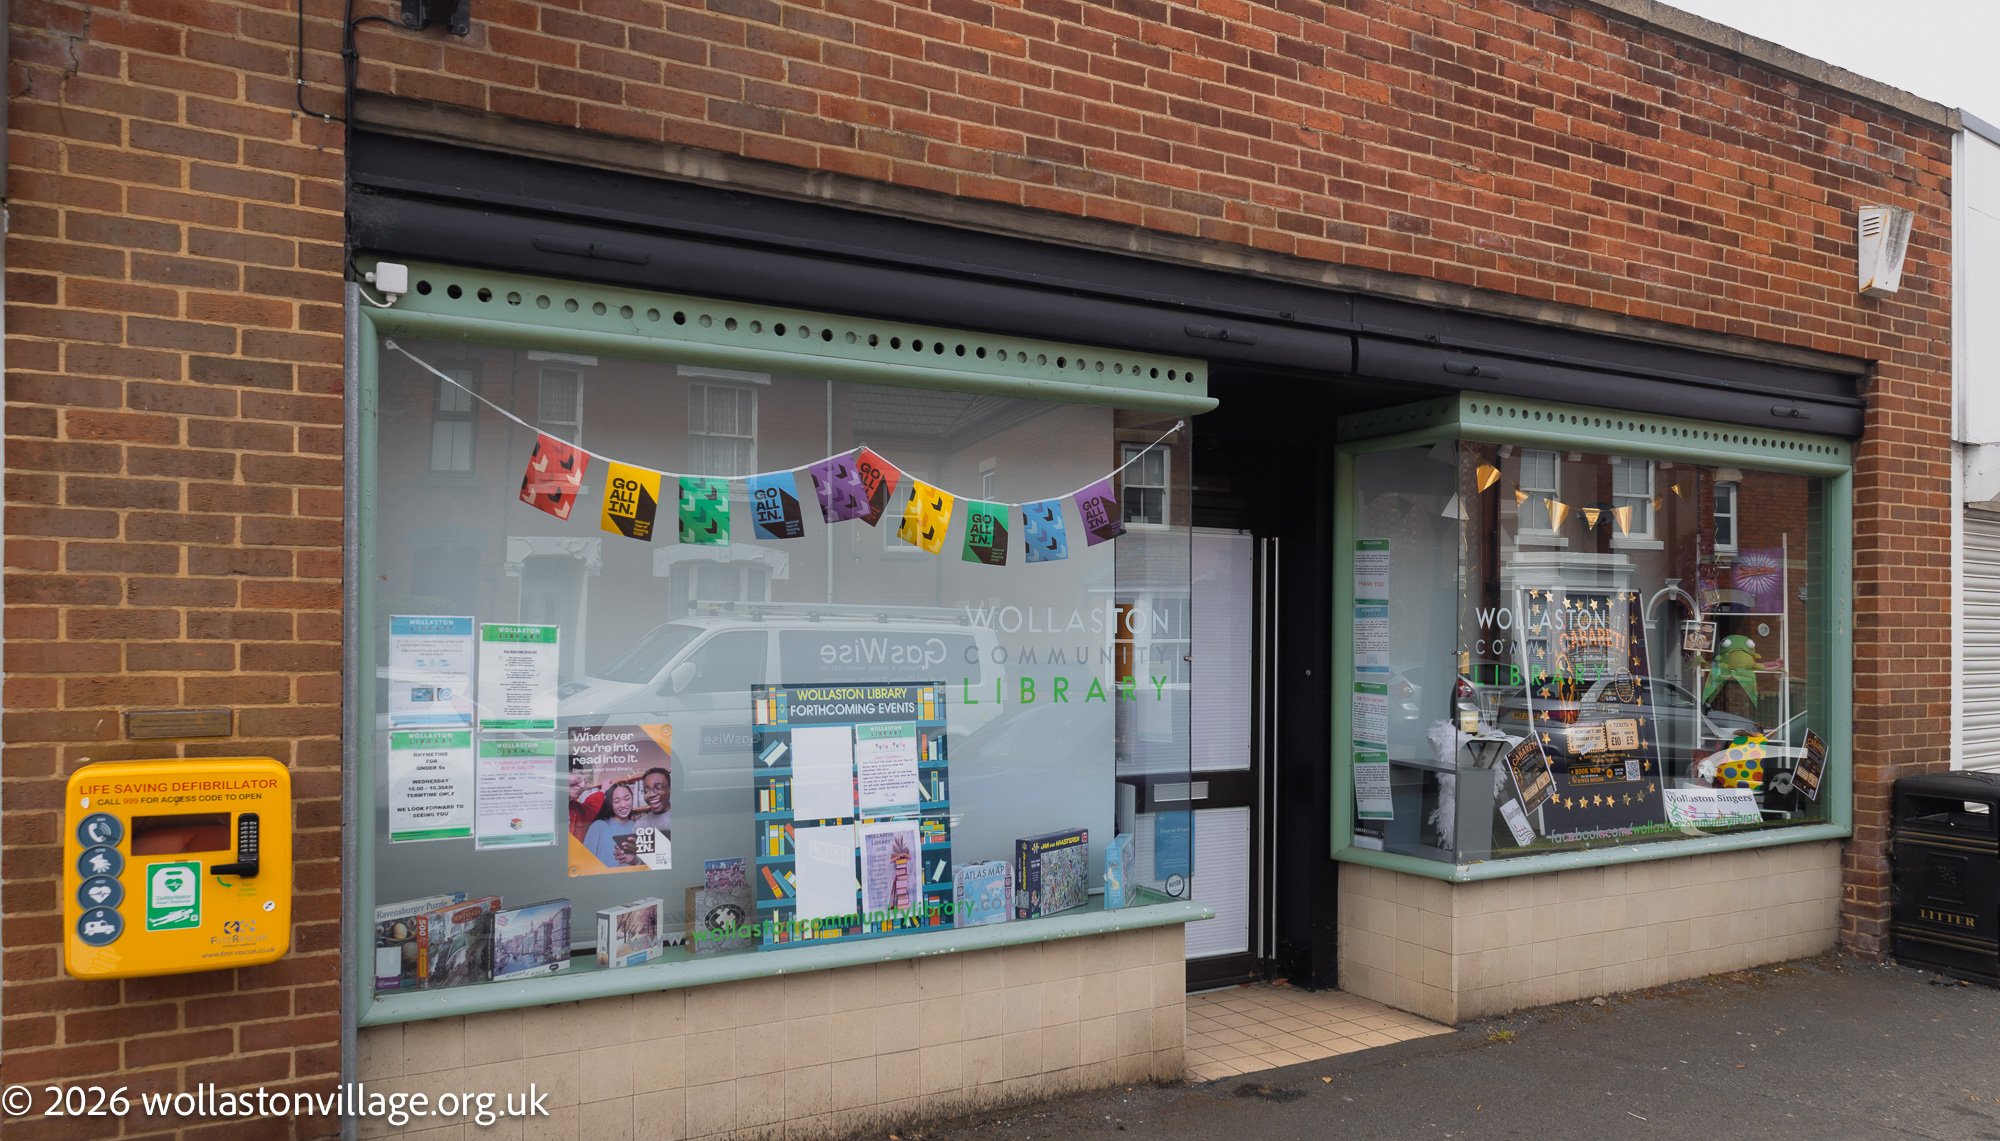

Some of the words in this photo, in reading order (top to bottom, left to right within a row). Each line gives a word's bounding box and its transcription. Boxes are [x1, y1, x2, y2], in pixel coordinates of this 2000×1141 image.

[861, 462, 880, 479] GO
[612, 478, 638, 492] GO
[609, 490, 635, 504] ALL
[754, 487, 778, 500] GO
[608, 500, 634, 516] IN.
[757, 499, 780, 511] ALL
[1083, 497, 1100, 511] GO
[758, 510, 782, 522] IN.
[972, 513, 992, 524] GO
[1086, 507, 1104, 521] ALL
[970, 523, 991, 534] ALL
[1088, 516, 1107, 530] IN.
[969, 533, 990, 544] IN.
[964, 605, 1170, 634] WOLLASTON
[1475, 607, 1606, 631] WOLLASTON
[964, 645, 1168, 665] COMMUNITY
[1474, 663, 1605, 687] LIBRARY
[796, 688, 865, 701] WOLLASTON
[866, 687, 907, 700] LIBRARY
[963, 675, 1168, 705] LIBRARY
[790, 704, 876, 717] FORTHCOMING
[878, 702, 915, 714] EVENTS
[573, 732, 634, 742] Whatever
[1611, 736, 1622, 746] £10
[1626, 736, 1634, 745] £5
[573, 744, 612, 754] you're
[613, 743, 639, 753] into,
[573, 755, 602, 765] read
[602, 755, 626, 765] into
[627, 754, 638, 764] it.
[80, 785, 111, 795] LIFE
[114, 783, 168, 794] SAVING
[172, 779, 278, 792] DEFIBRILLATOR
[161, 795, 196, 804] ACCESS
[198, 794, 223, 802] CODE
[1666, 794, 1714, 803] Wollaston
[1716, 794, 1753, 804] Singers
[635, 827, 654, 836] GO
[635, 835, 654, 844] ALL
[1041, 842, 1050, 850] JAN
[636, 844, 654, 853] IN.
[965, 868, 987, 881] ATLAS
[988, 866, 1005, 877] MAP
[376, 903, 425, 919] Ravensburger
[426, 899, 448, 910] Puzzle
[1919, 908, 1976, 927] LITTER
[418, 919, 427, 937] 500
